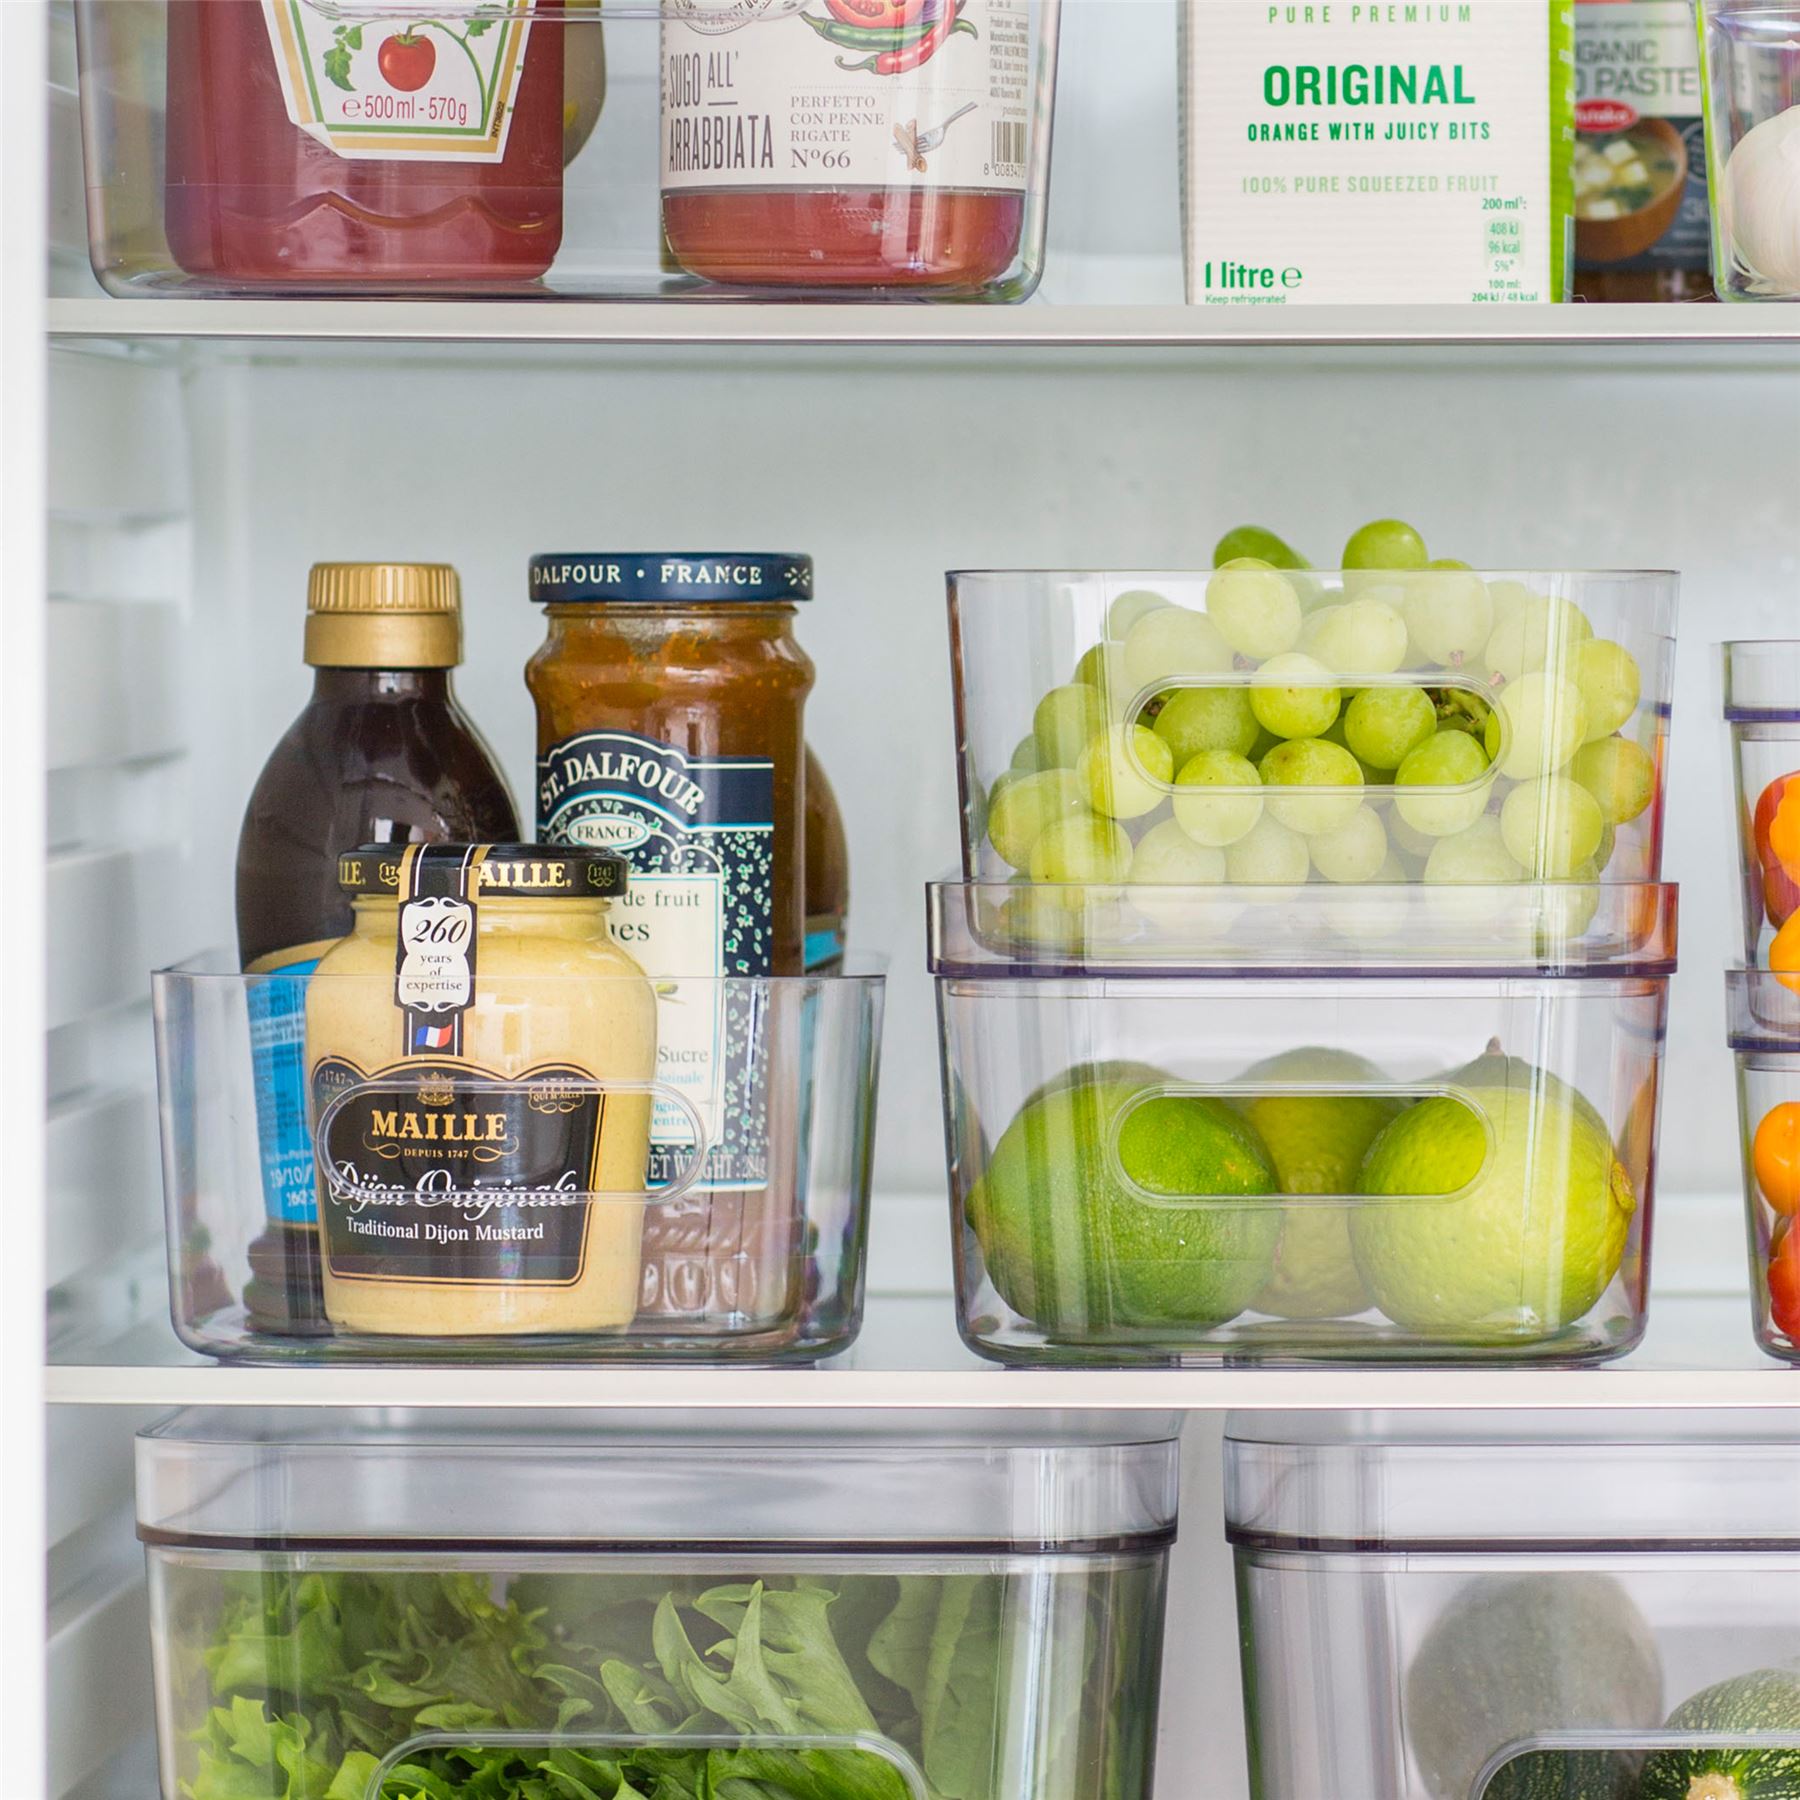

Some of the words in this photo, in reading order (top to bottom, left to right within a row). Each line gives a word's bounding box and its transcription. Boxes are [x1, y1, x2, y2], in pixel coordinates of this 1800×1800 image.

[1268, 6, 1332, 24] PURE
[1352, 5, 1472, 23] PREMIUM
[1576, 39, 1658, 62] GANIC
[669, 52, 701, 109] SUGO
[1263, 64, 1476, 107] ORIGINAL
[1594, 66, 1698, 97] PASTE
[790, 96, 876, 109] PERFETTO
[790, 112, 824, 125] CON
[828, 112, 885, 125] PENNE
[790, 129, 851, 142] RIGATE
[1247, 123, 1320, 142] ORANGE
[1329, 122, 1376, 141] WITH
[1384, 122, 1440, 140] JUICY
[1449, 121, 1491, 140] BITS
[668, 114, 775, 173] ARRABBIATA
[1242, 176, 1287, 194] 100%
[1294, 176, 1340, 193] PURE
[1347, 175, 1439, 192] SQUEEZED
[1447, 175, 1499, 192] FRUIT
[1482, 198, 1503, 210] 200
[1502, 240, 1521, 253] kcal
[1205, 262, 1212, 288] 1
[1221, 262, 1274, 289] litre
[1205, 294, 1230, 305] Keep
[1231, 293, 1287, 305] refrigerated
[1519, 291, 1539, 301] kcal
[534, 564, 622, 585] DALFOUR
[660, 563, 763, 585] FRANCE
[564, 752, 706, 815] DALFOUR
[576, 826, 638, 840] FRANCE
[478, 862, 565, 888] AILLE
[623, 889, 646, 907] de
[655, 889, 700, 907] fruit
[410, 915, 468, 944] 260
[420, 954, 453, 966] years
[430, 967, 442, 977] of
[406, 979, 463, 993] expertise
[658, 1047, 708, 1063] Sucre
[371, 1109, 508, 1141] MAILLE
[404, 1148, 444, 1159] DEPUIS
[447, 1149, 469, 1159] 1747
[329, 1160, 409, 1213] Dijon
[346, 1216, 419, 1240] Traditional
[425, 1224, 469, 1244] Dijon
[475, 1223, 544, 1242] Mustard
